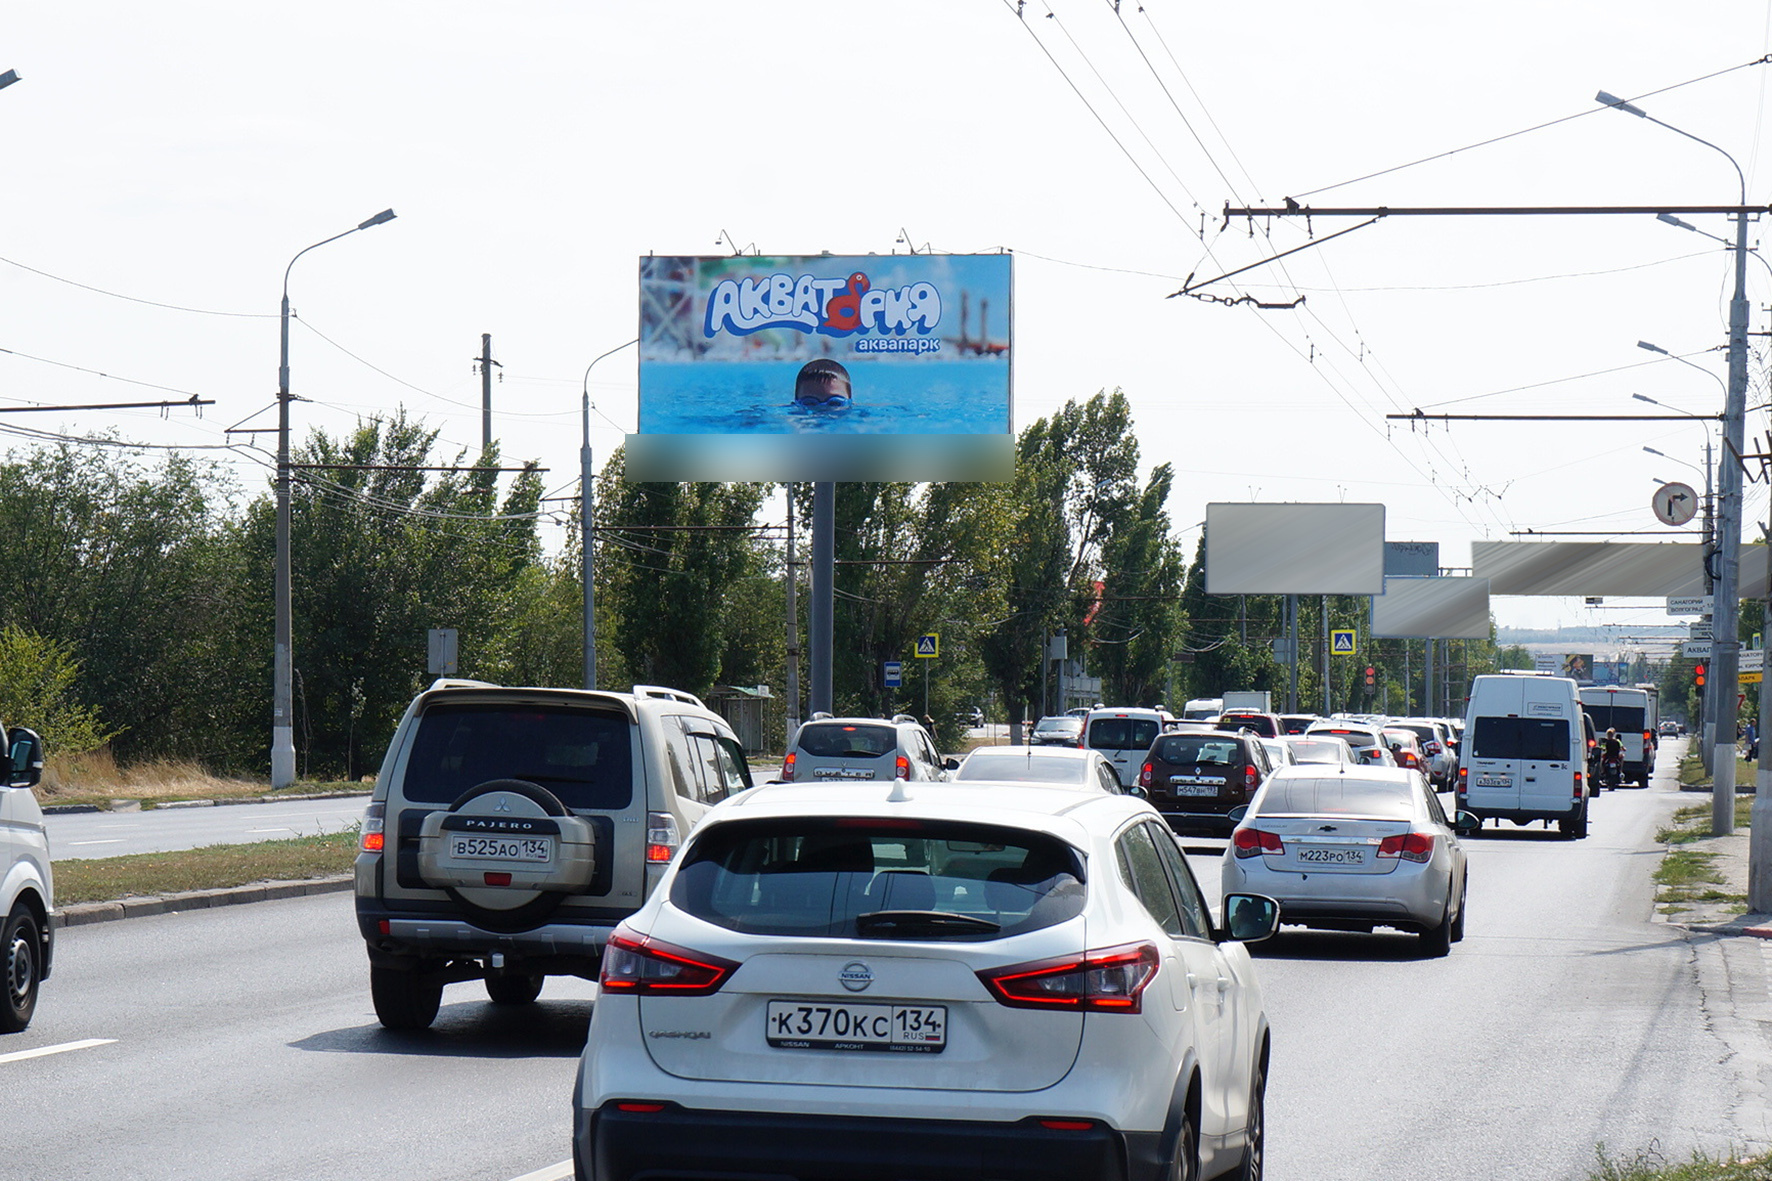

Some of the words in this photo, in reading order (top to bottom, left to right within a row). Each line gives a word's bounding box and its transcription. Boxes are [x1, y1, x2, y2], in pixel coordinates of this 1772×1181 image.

[704, 272, 943, 338] АКВАТОРИЯ
[857, 338, 941, 355] аквапарк
[466, 819, 533, 830] PAJERO
[521, 840, 545, 854] 134
[1345, 851, 1361, 860] 134
[841, 972, 871, 980] NISSAN
[895, 1009, 937, 1032] 134
[903, 1031, 925, 1041] RUS
[834, 1042, 864, 1050] АРКОНТ
